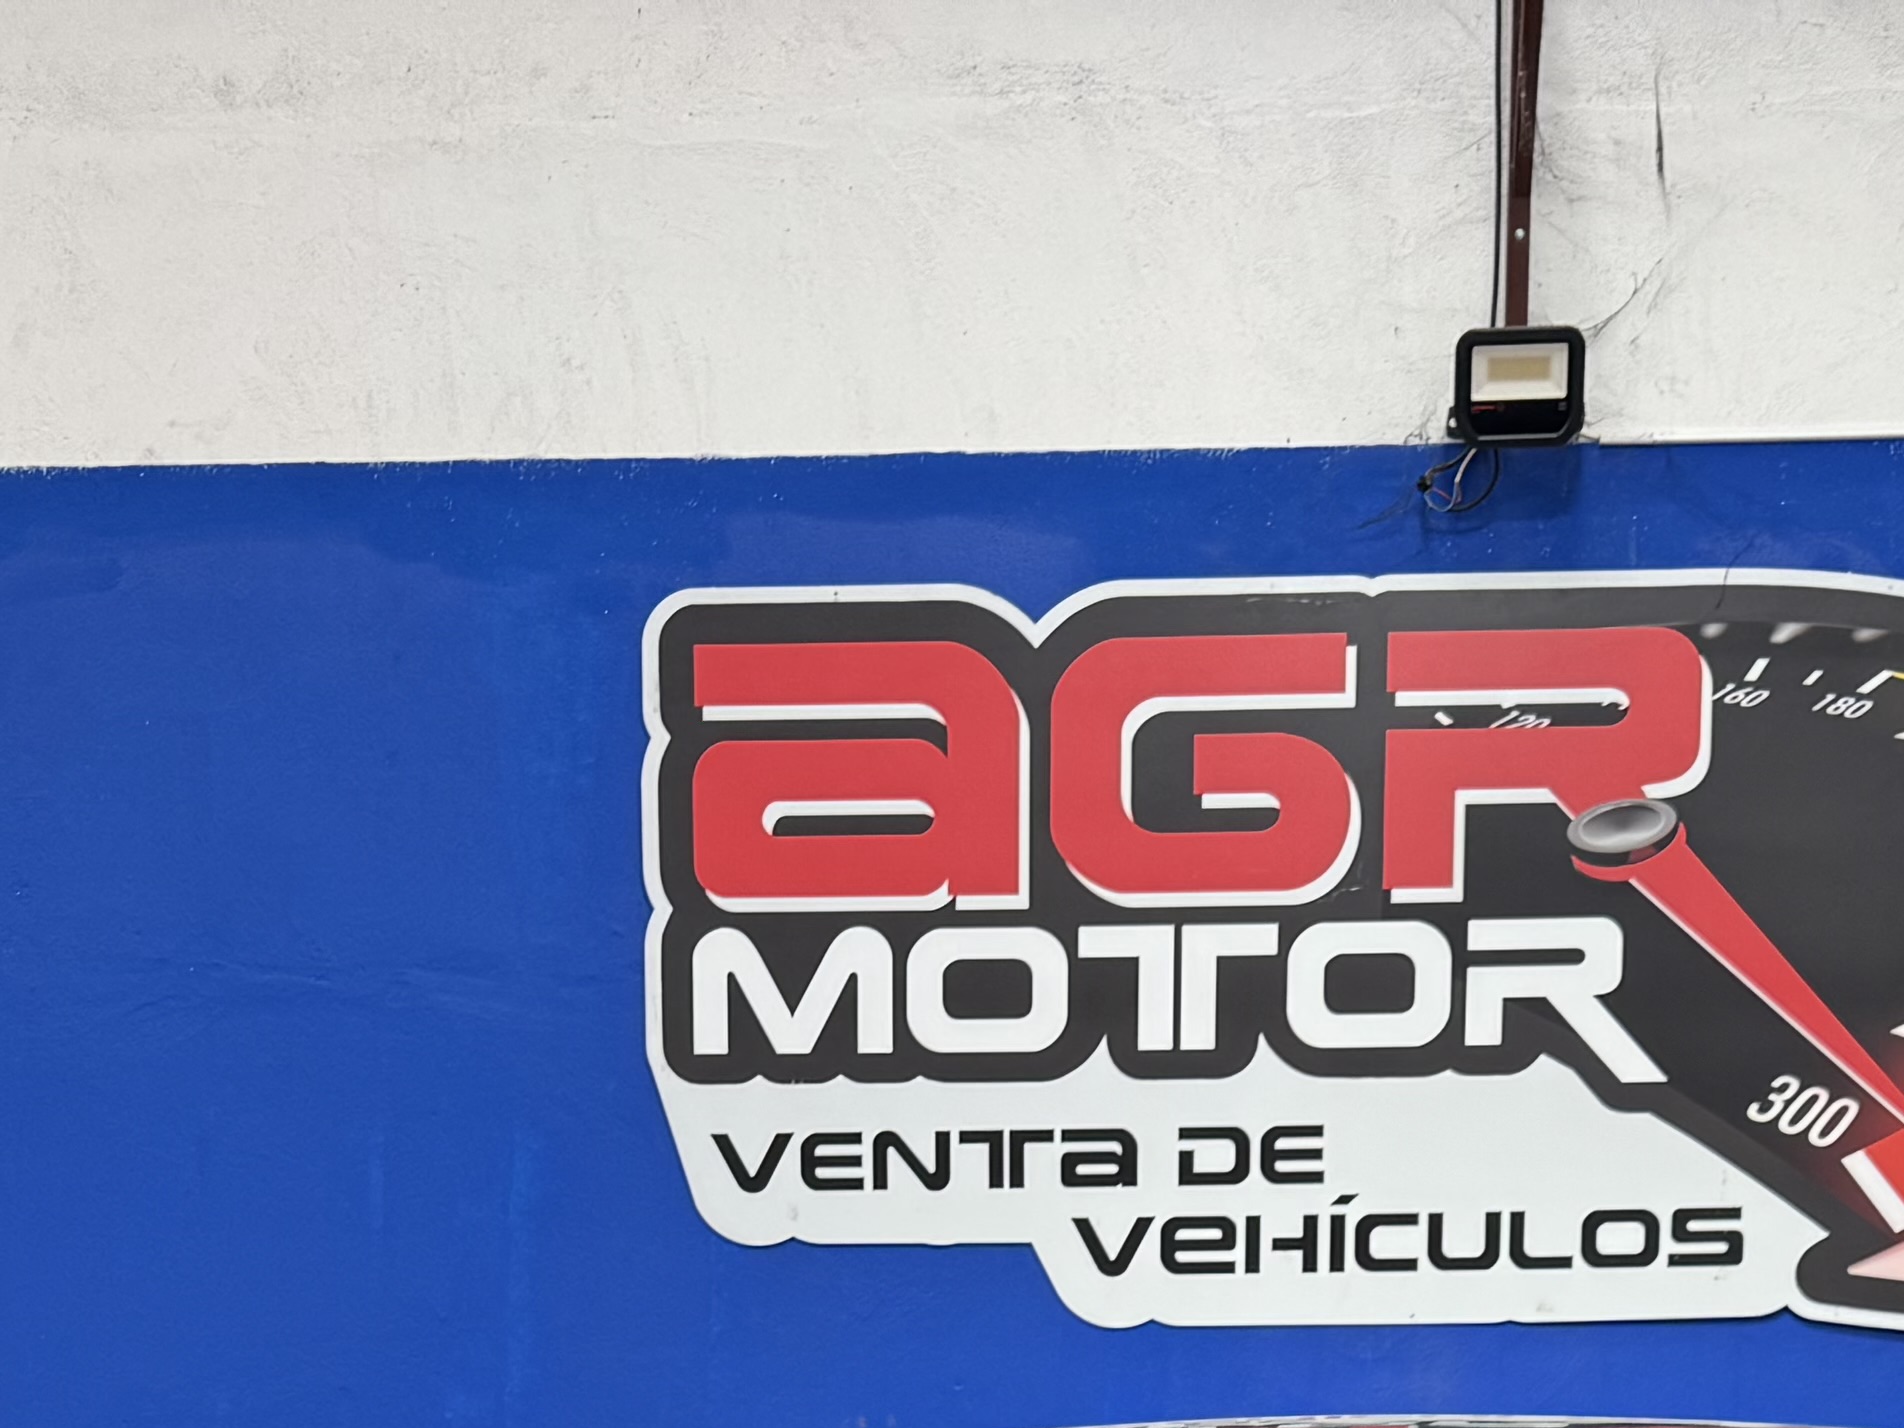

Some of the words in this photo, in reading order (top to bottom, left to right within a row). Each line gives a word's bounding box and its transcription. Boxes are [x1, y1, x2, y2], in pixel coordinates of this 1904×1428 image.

[1712, 683, 1770, 707] 160
[1812, 693, 1874, 718] 180
[693, 916, 1667, 1082] MOTOR
[1746, 1075, 1860, 1148] 300
[1178, 1124, 1325, 1187] DE
